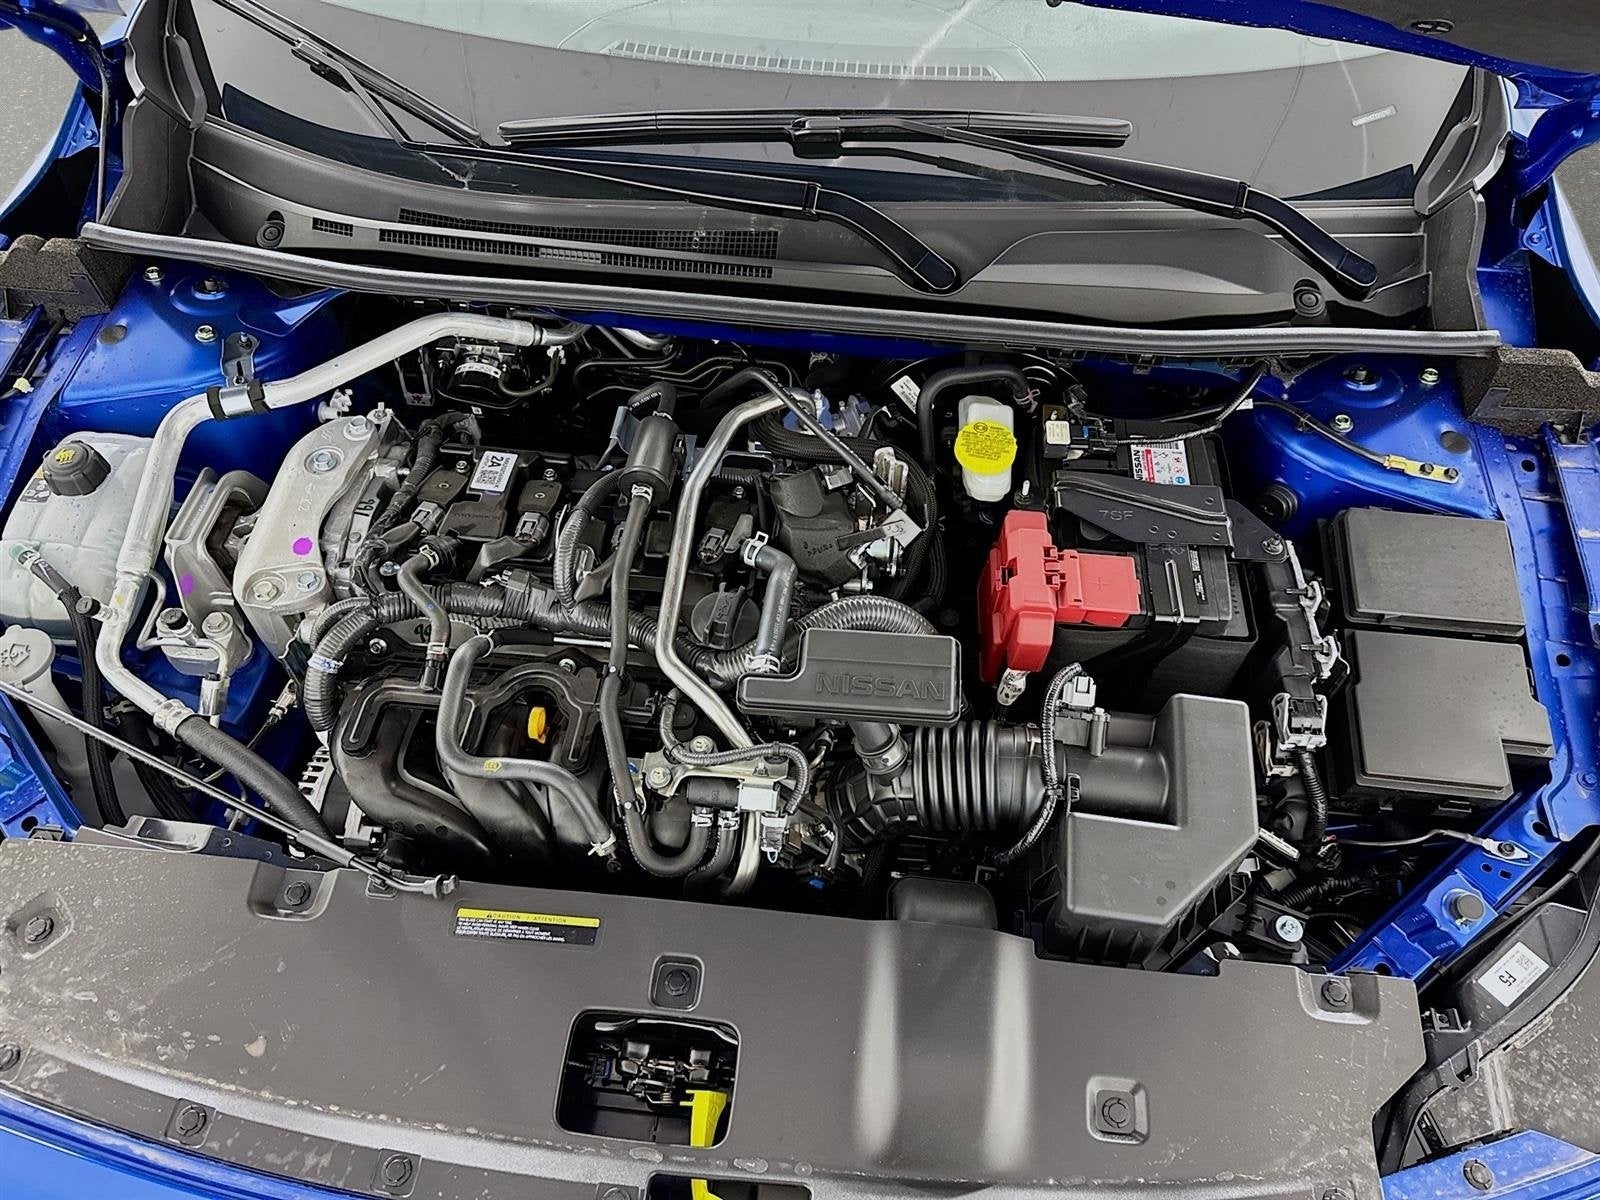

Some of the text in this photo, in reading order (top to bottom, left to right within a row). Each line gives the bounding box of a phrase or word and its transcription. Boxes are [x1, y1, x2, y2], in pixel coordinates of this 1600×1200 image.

[488, 455, 504, 468] 2A
[1133, 449, 1144, 481] NISSAN
[1098, 510, 1134, 521] 7SF
[815, 672, 945, 701] NISSAN
[493, 912, 521, 921] CAUTION
[533, 916, 567, 924] ATTENTION
[1498, 970, 1517, 987] F5
